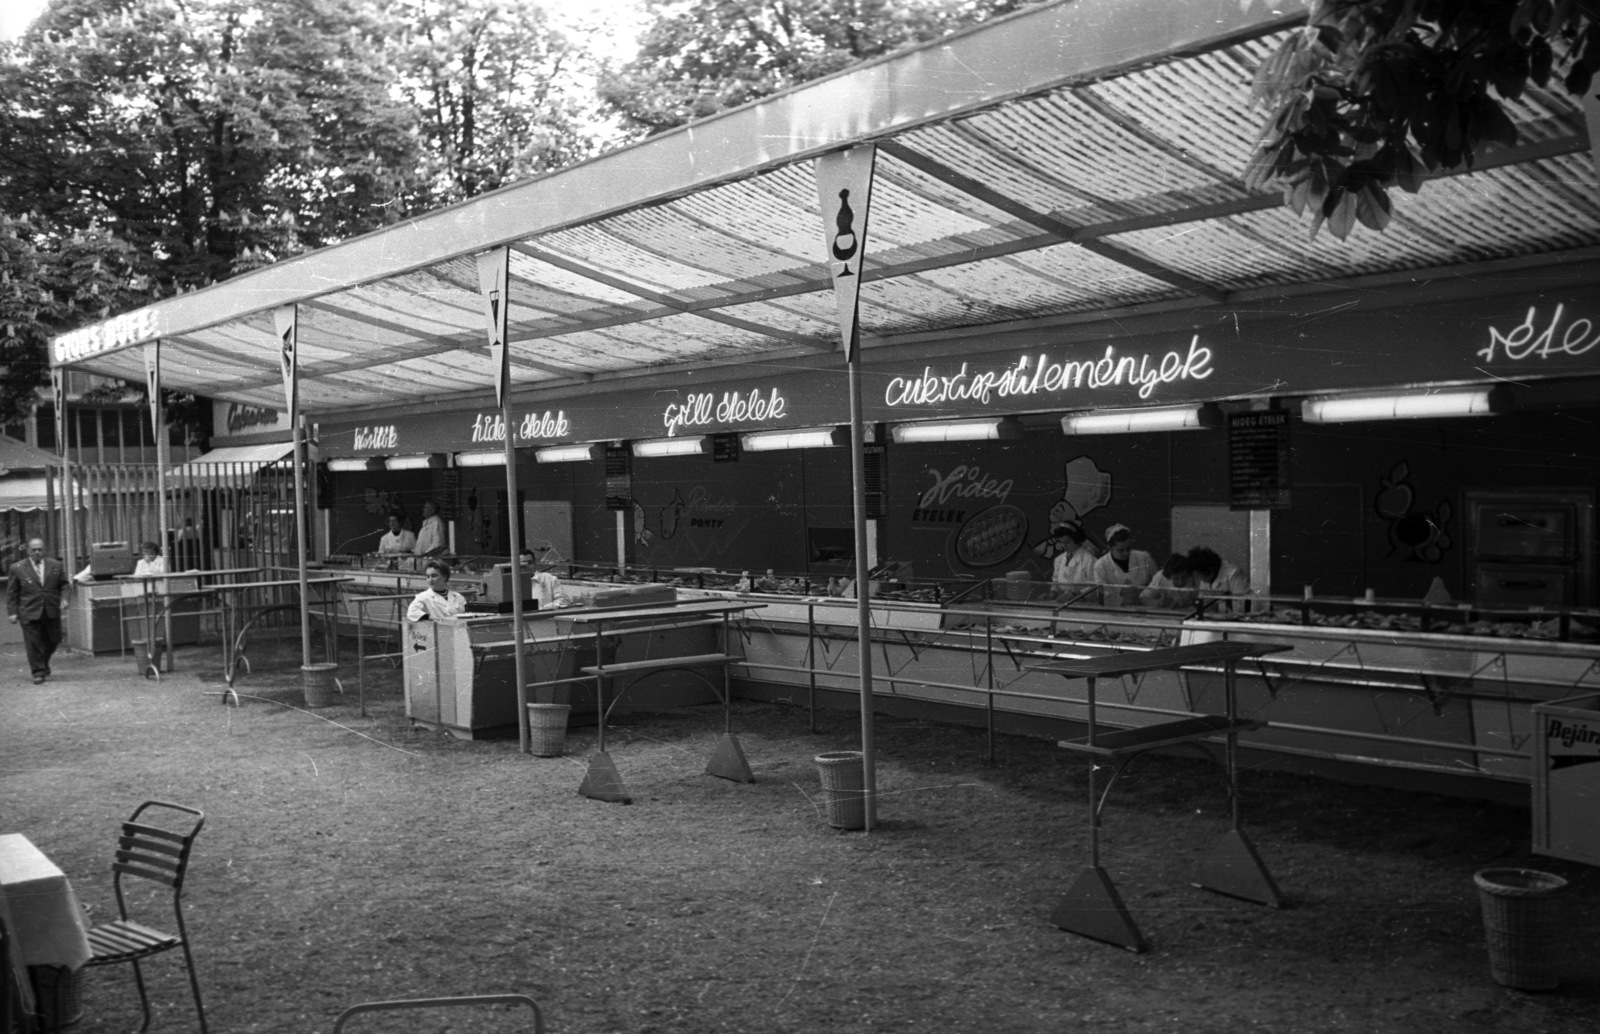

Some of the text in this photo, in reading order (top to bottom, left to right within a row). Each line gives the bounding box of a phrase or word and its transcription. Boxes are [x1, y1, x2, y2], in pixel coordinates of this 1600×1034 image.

[885, 334, 1213, 405] cukrászsütemények
[716, 387, 786, 422] ételek
[471, 410, 569, 444] hide ételek
[690, 518, 724, 528] PONTY
